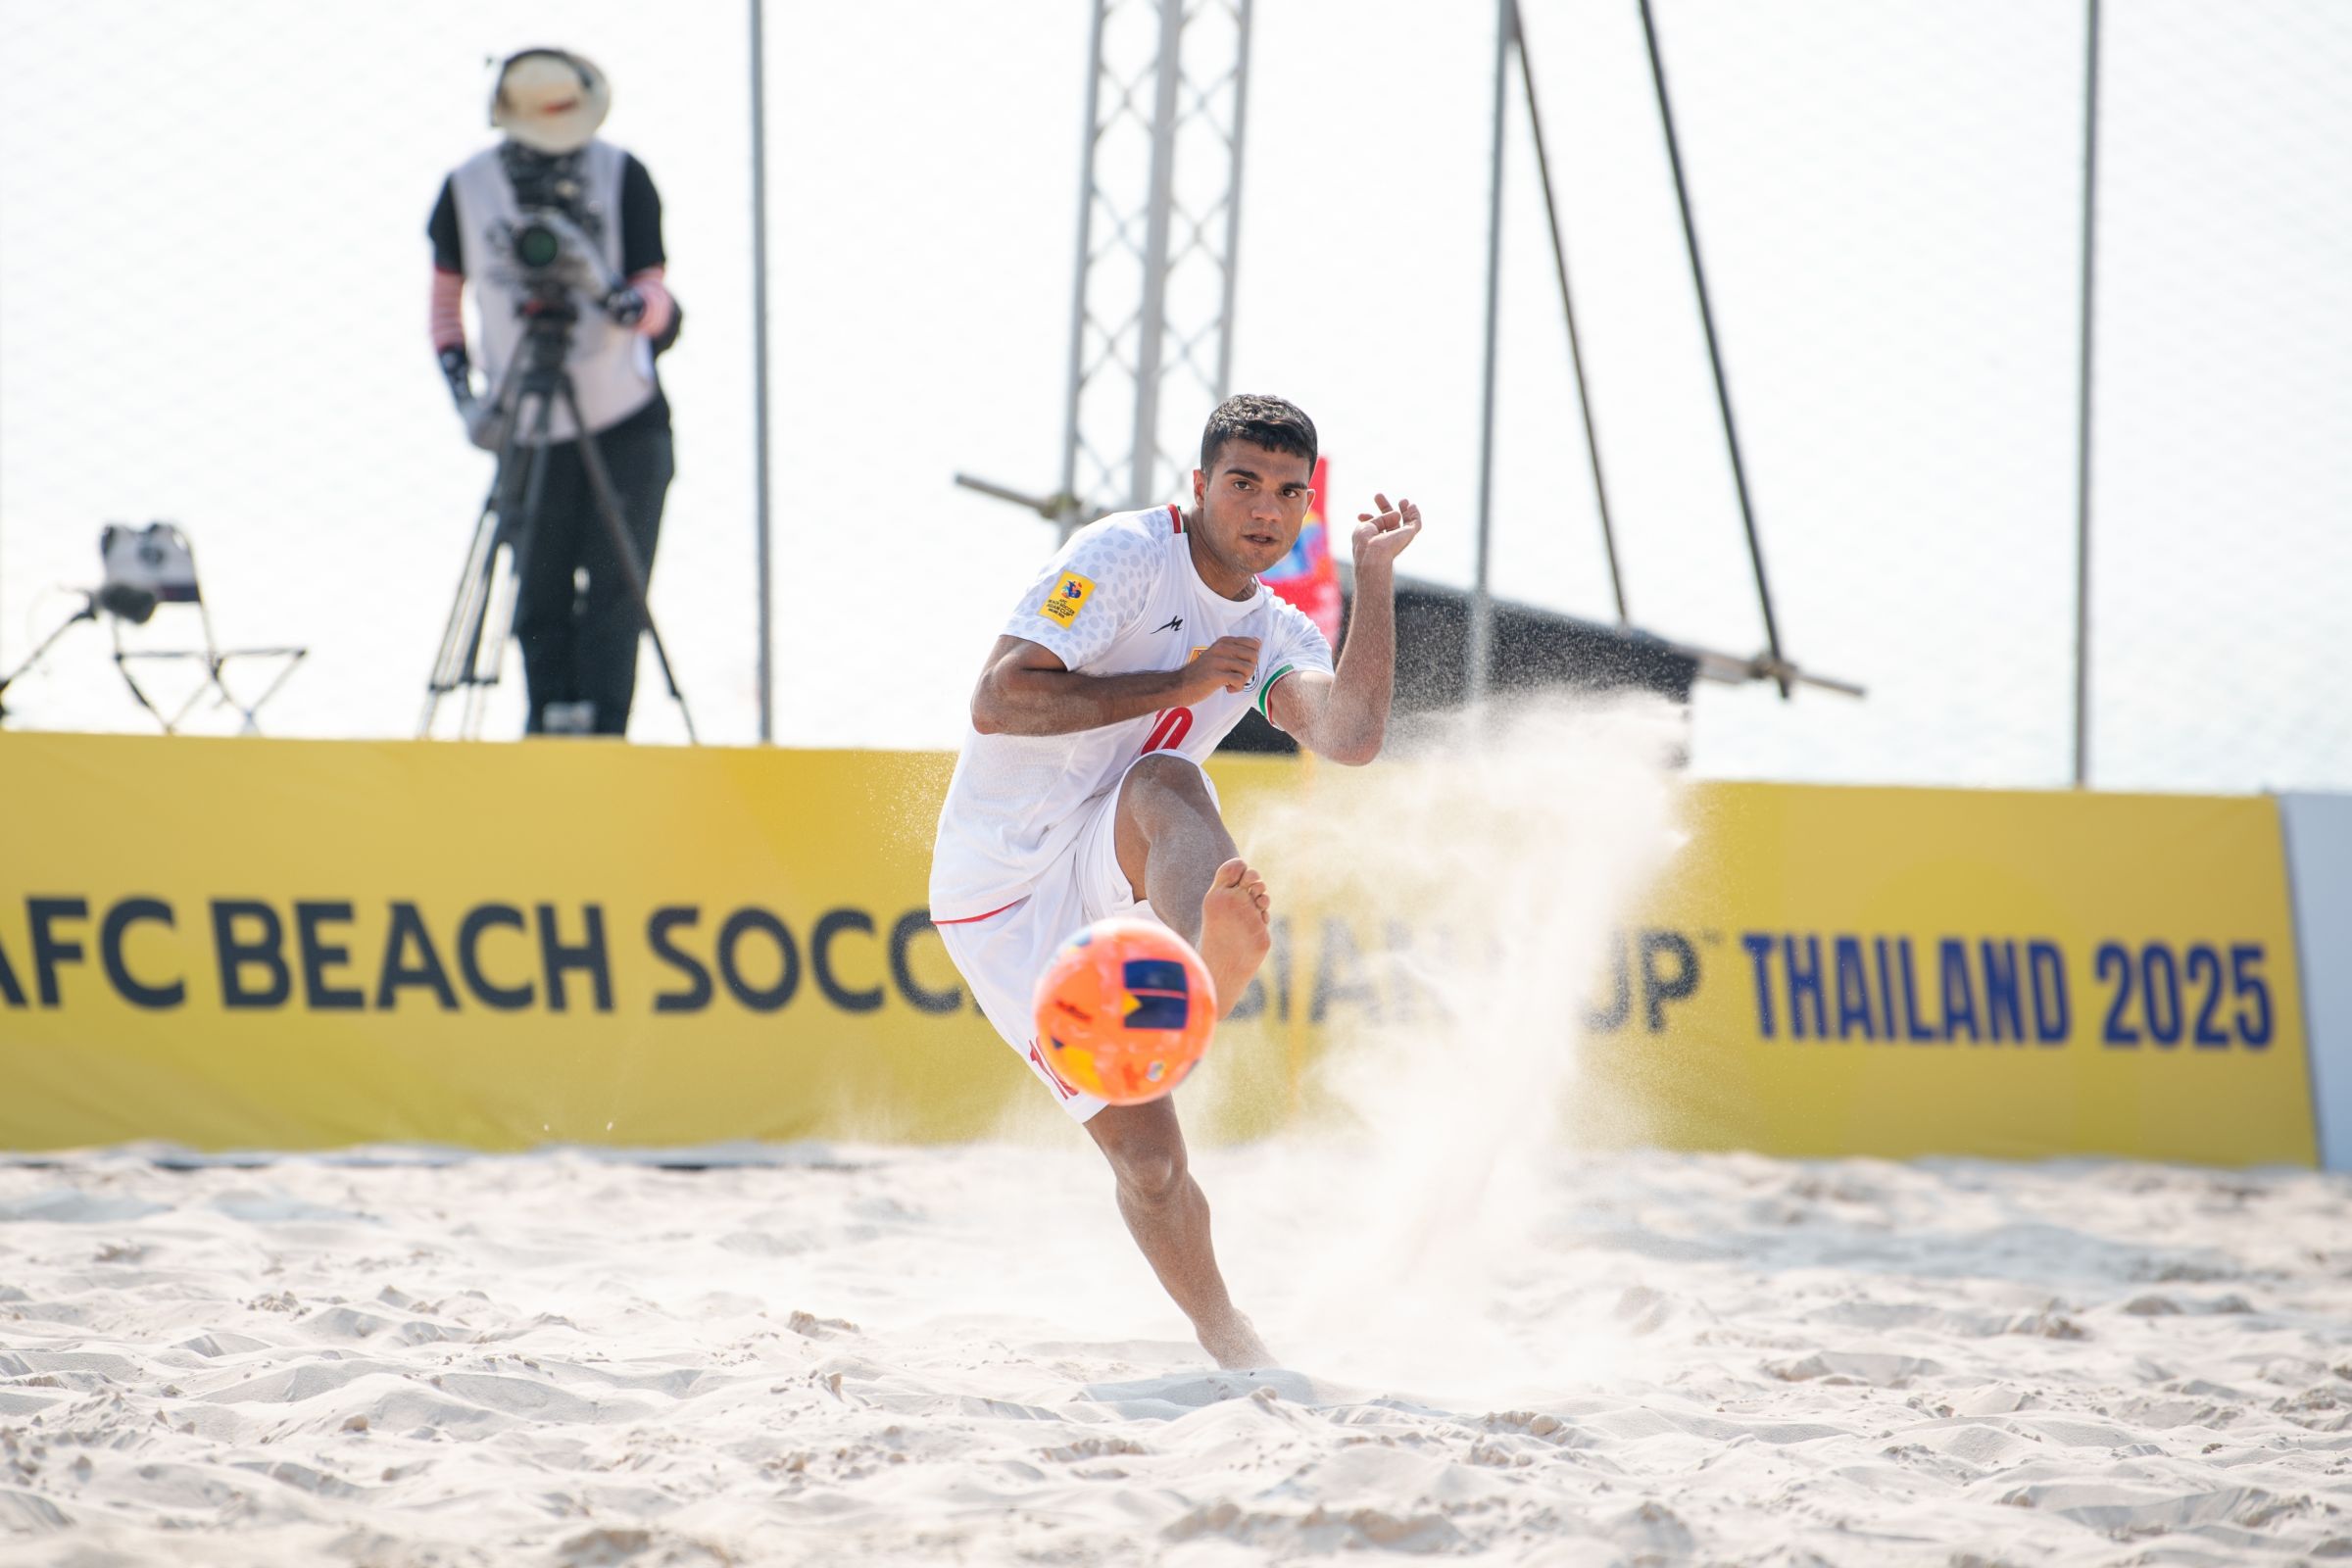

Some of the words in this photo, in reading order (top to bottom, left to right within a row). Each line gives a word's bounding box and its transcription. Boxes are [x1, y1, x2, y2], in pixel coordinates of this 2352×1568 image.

[208, 897, 615, 1015] BEACH
[646, 905, 985, 1017] SOCC
[1740, 931, 2073, 1047] THAILAND
[2092, 938, 2276, 1051] 2025
